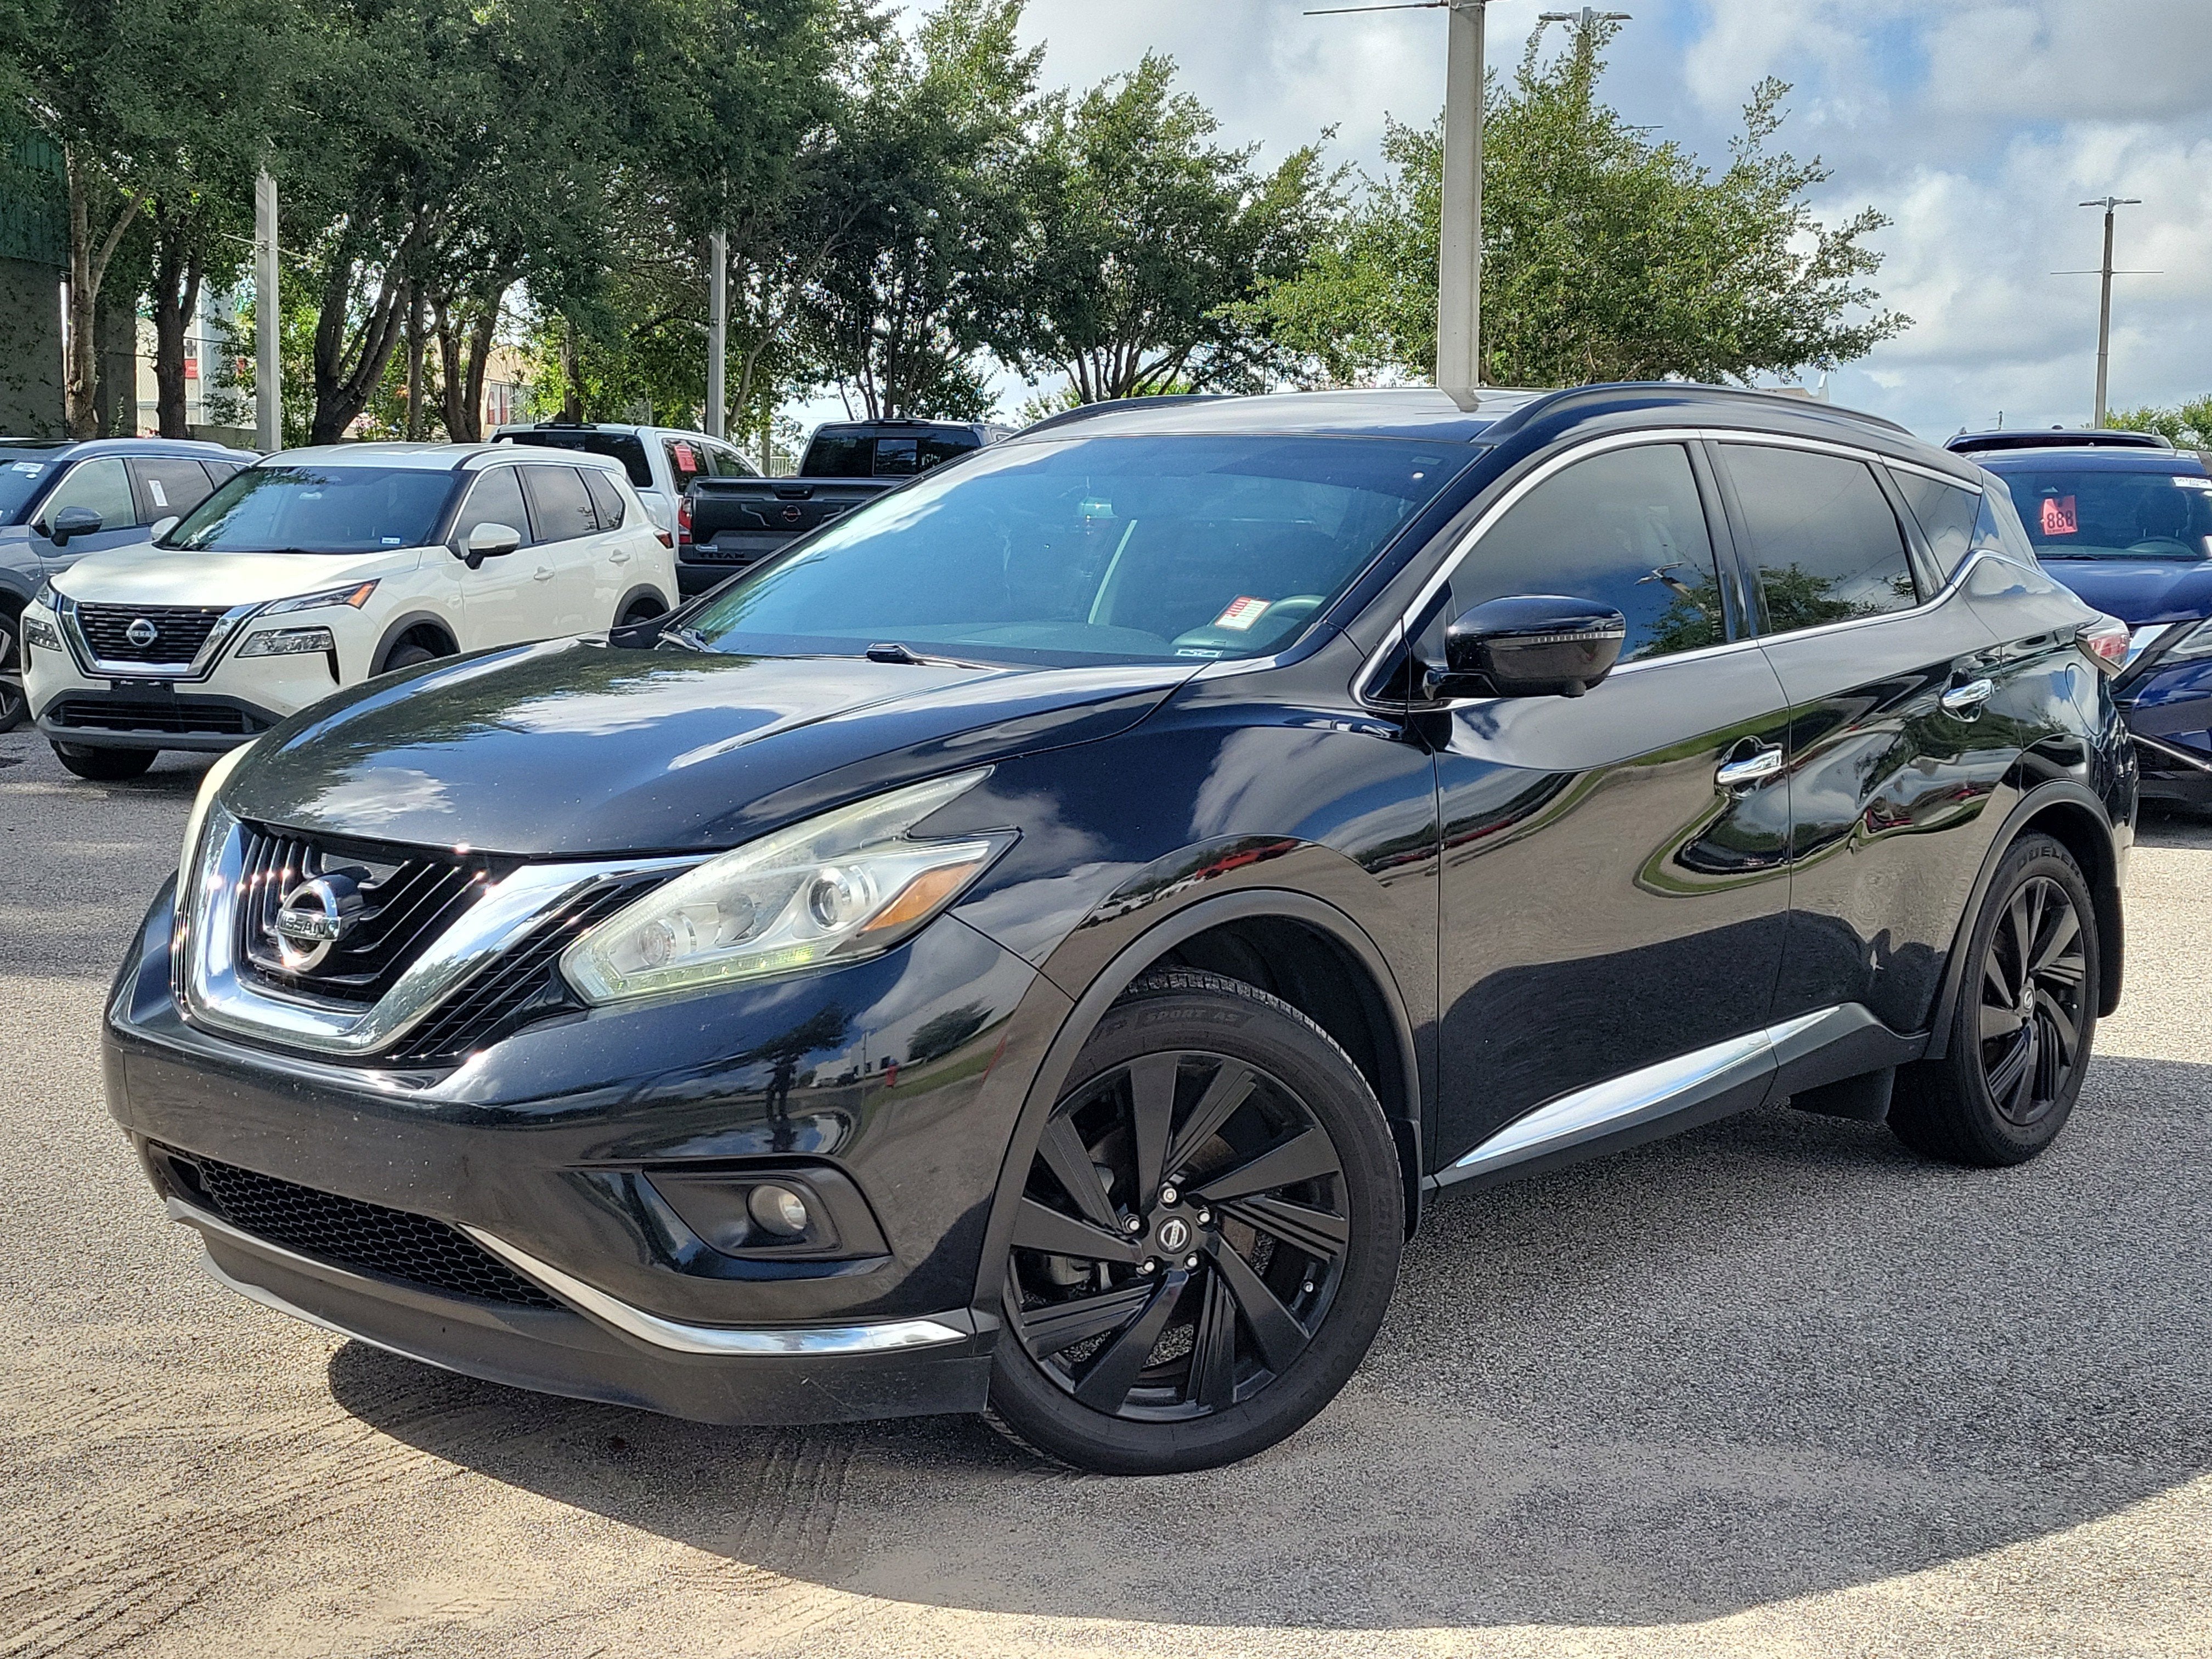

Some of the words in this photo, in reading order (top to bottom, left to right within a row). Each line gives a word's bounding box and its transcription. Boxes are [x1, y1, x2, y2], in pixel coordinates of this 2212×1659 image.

[2047, 510, 2074, 529] 888
[2017, 847, 2080, 878] DUELER
[1147, 1009, 1206, 1022] SPORT
